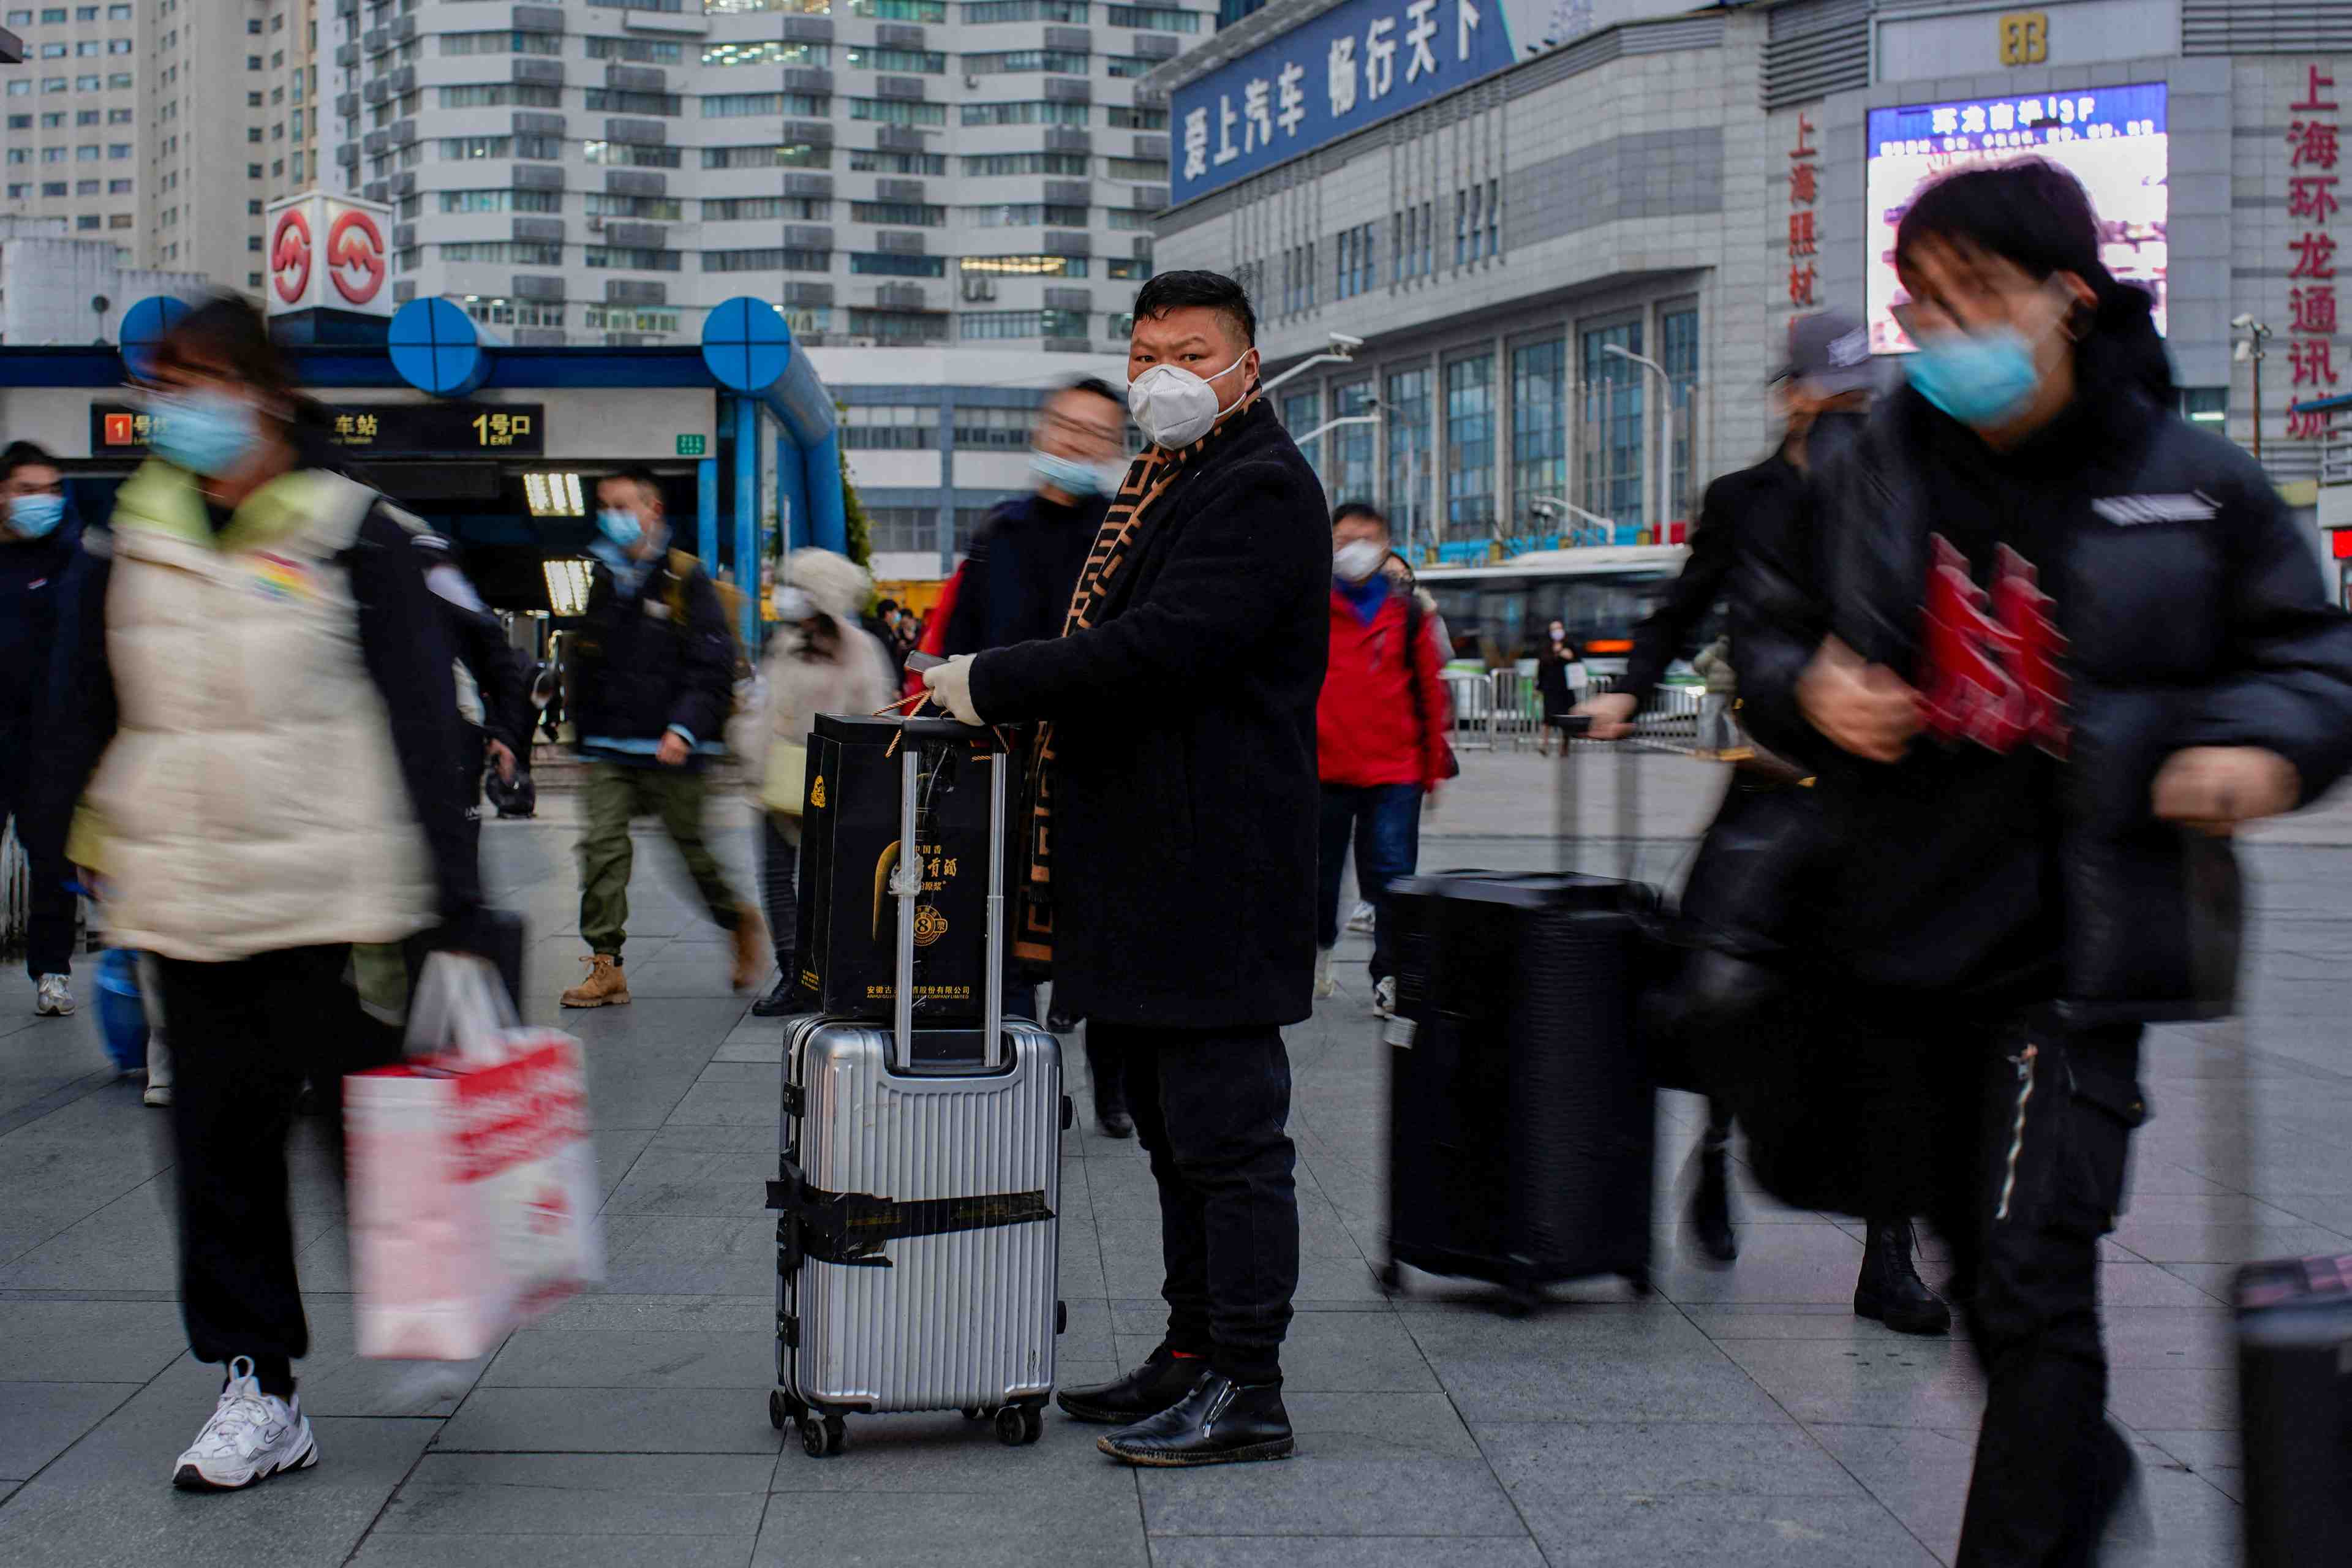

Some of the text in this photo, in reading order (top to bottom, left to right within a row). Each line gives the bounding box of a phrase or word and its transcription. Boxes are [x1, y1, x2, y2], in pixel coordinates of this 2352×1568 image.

[1184, 0, 1480, 181] 爱上汽车 畅行天下
[1788, 111, 1817, 337] 上海照材
[2286, 64, 2339, 440] 上海环龙通讯城
[490, 435, 513, 445] EXIT
